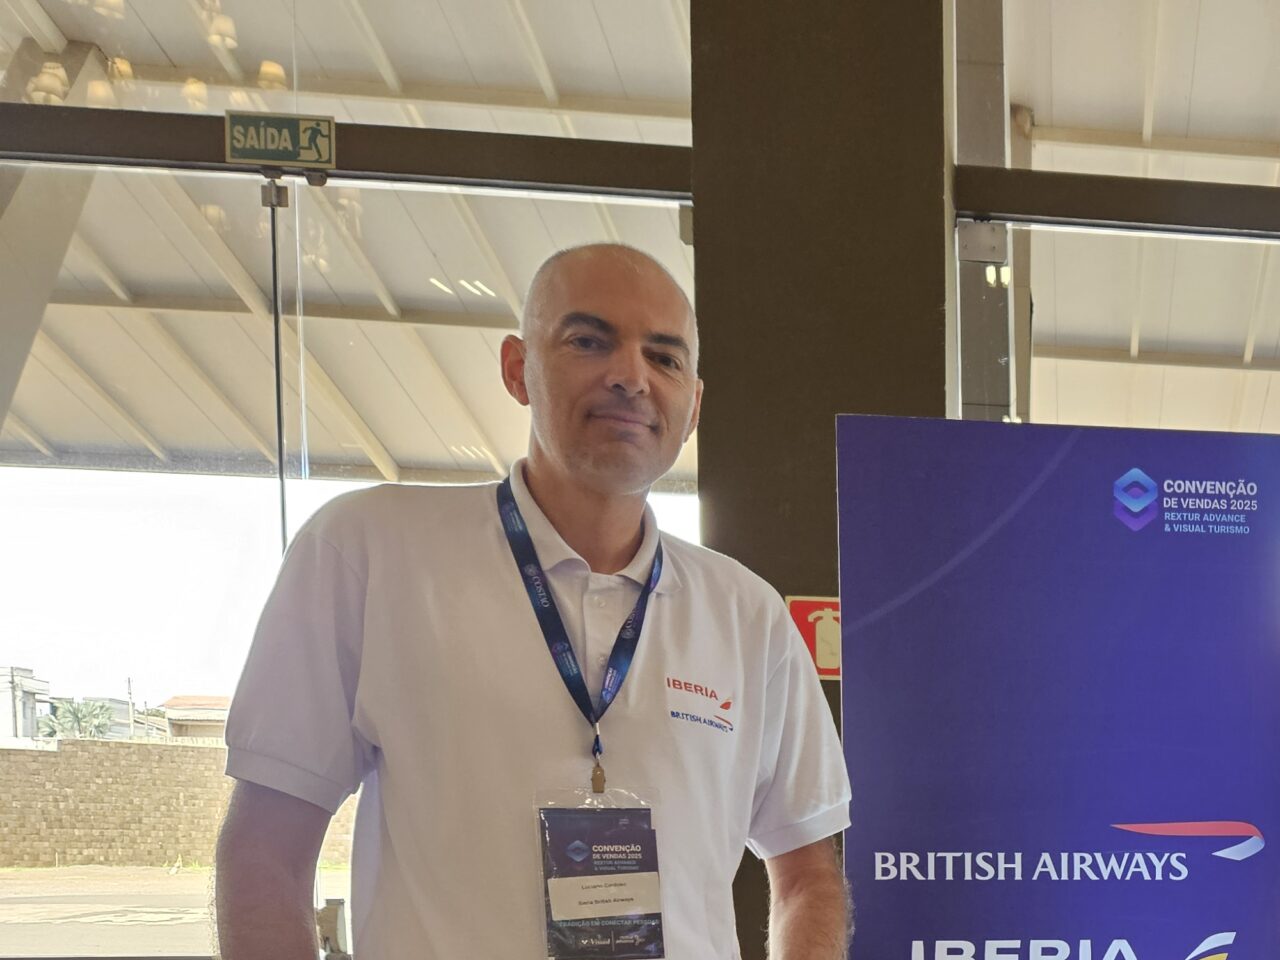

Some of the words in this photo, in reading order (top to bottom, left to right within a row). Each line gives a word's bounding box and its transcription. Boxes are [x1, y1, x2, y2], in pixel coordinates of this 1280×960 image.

[232, 120, 293, 152] SAÍDA
[1163, 479, 1258, 498] CONVENÇÃO
[1163, 497, 1178, 508] DE
[1181, 498, 1227, 510] VENDAS
[1230, 499, 1258, 511] 2025
[1164, 512, 1201, 521] REXTUR
[1203, 513, 1246, 523] ADVANCE
[1164, 523, 1171, 532] &
[1173, 524, 1206, 533] VISUAL
[1208, 525, 1250, 534] TURISMO
[666, 677, 719, 701] IBERIA
[874, 852, 1023, 881] BRITISH
[1032, 852, 1190, 881] AIRWAYS
